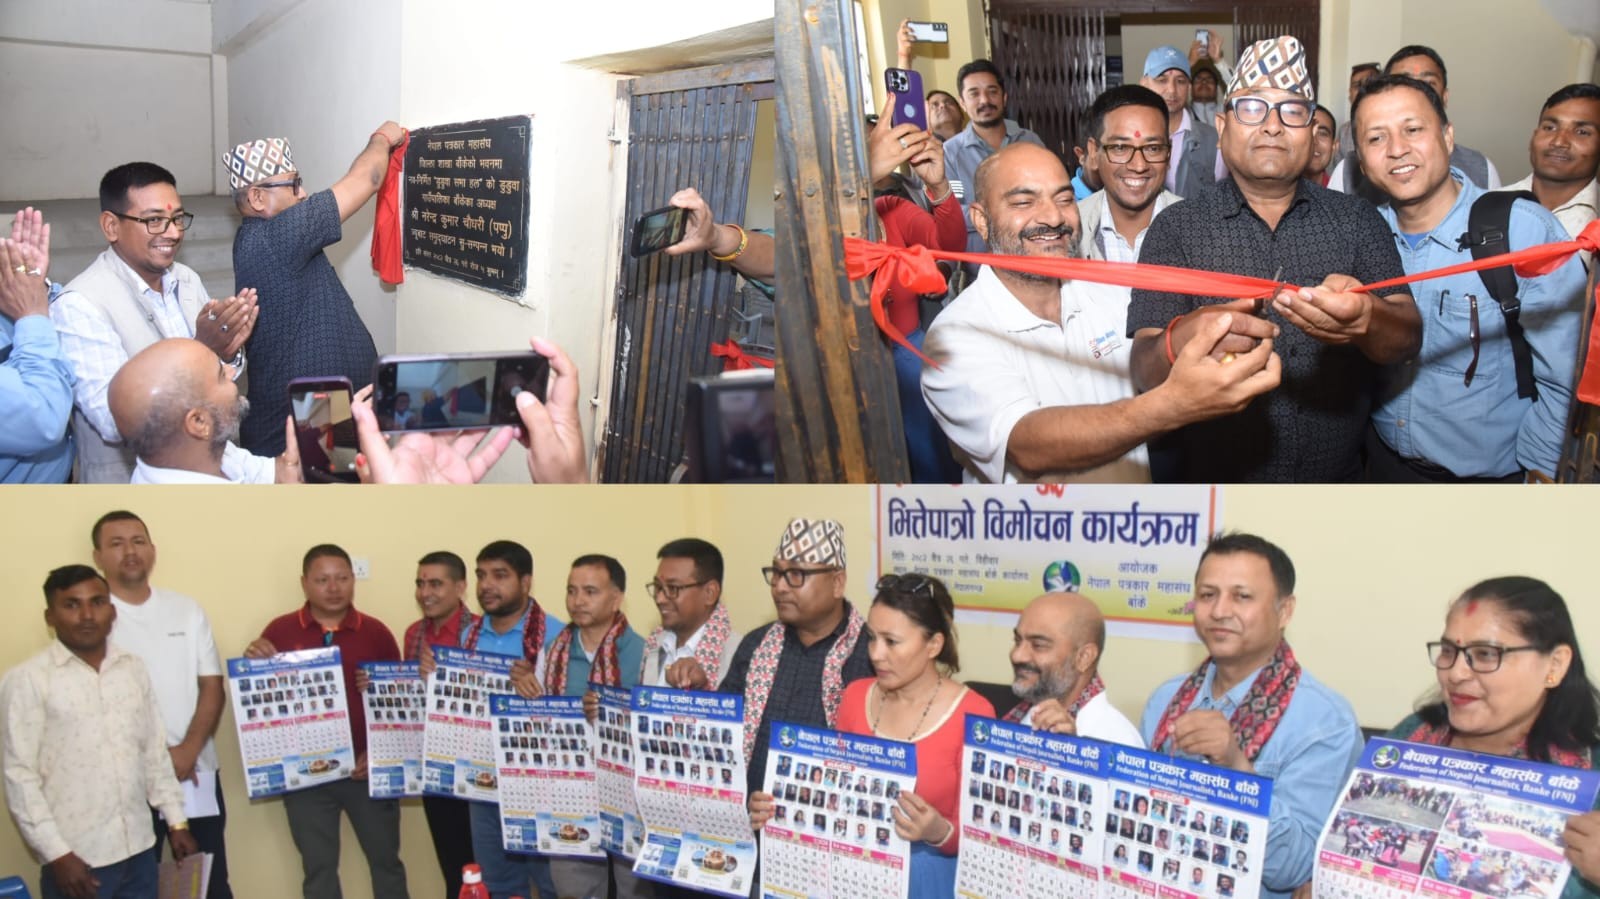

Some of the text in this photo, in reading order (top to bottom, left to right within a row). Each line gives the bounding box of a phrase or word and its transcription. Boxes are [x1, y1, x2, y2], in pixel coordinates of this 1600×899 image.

[428, 137, 491, 151] नेपाल पत्रकार महासंघ
[480, 159, 502, 169] भवनमा
[486, 176, 495, 190] को
[499, 180, 520, 194] डुडुवा
[422, 208, 437, 224] नरेन्द्र
[440, 214, 459, 229] कुमार
[463, 214, 484, 232] चौधरी
[491, 243, 505, 257] भयो
[889, 497, 1199, 547] भित्तेपात्रो विमोचन कार्यक्रम
[1118, 560, 1158, 574] आयोजक
[1088, 576, 1191, 593] नेपाल पत्रकार महासंघ
[1116, 751, 1146, 768] नेपाल
[1149, 761, 1186, 780] पत्रकार
[1403, 749, 1440, 765] नेपाल
[1441, 756, 1490, 774] पत्रकार
[1116, 765, 1149, 779] Federation
[1151, 772, 1157, 781] of
[1158, 774, 1178, 787] Nepali
[1217, 790, 1238, 802] Banke
[1240, 794, 1259, 808] (FNJ)
[1399, 762, 1437, 775] Federation
[1439, 768, 1448, 776] of
[1448, 769, 1472, 782] Nepali
[1473, 774, 1520, 792] Journalists,
[1522, 784, 1550, 797] Banke
[1552, 790, 1576, 804] (FNJ)
